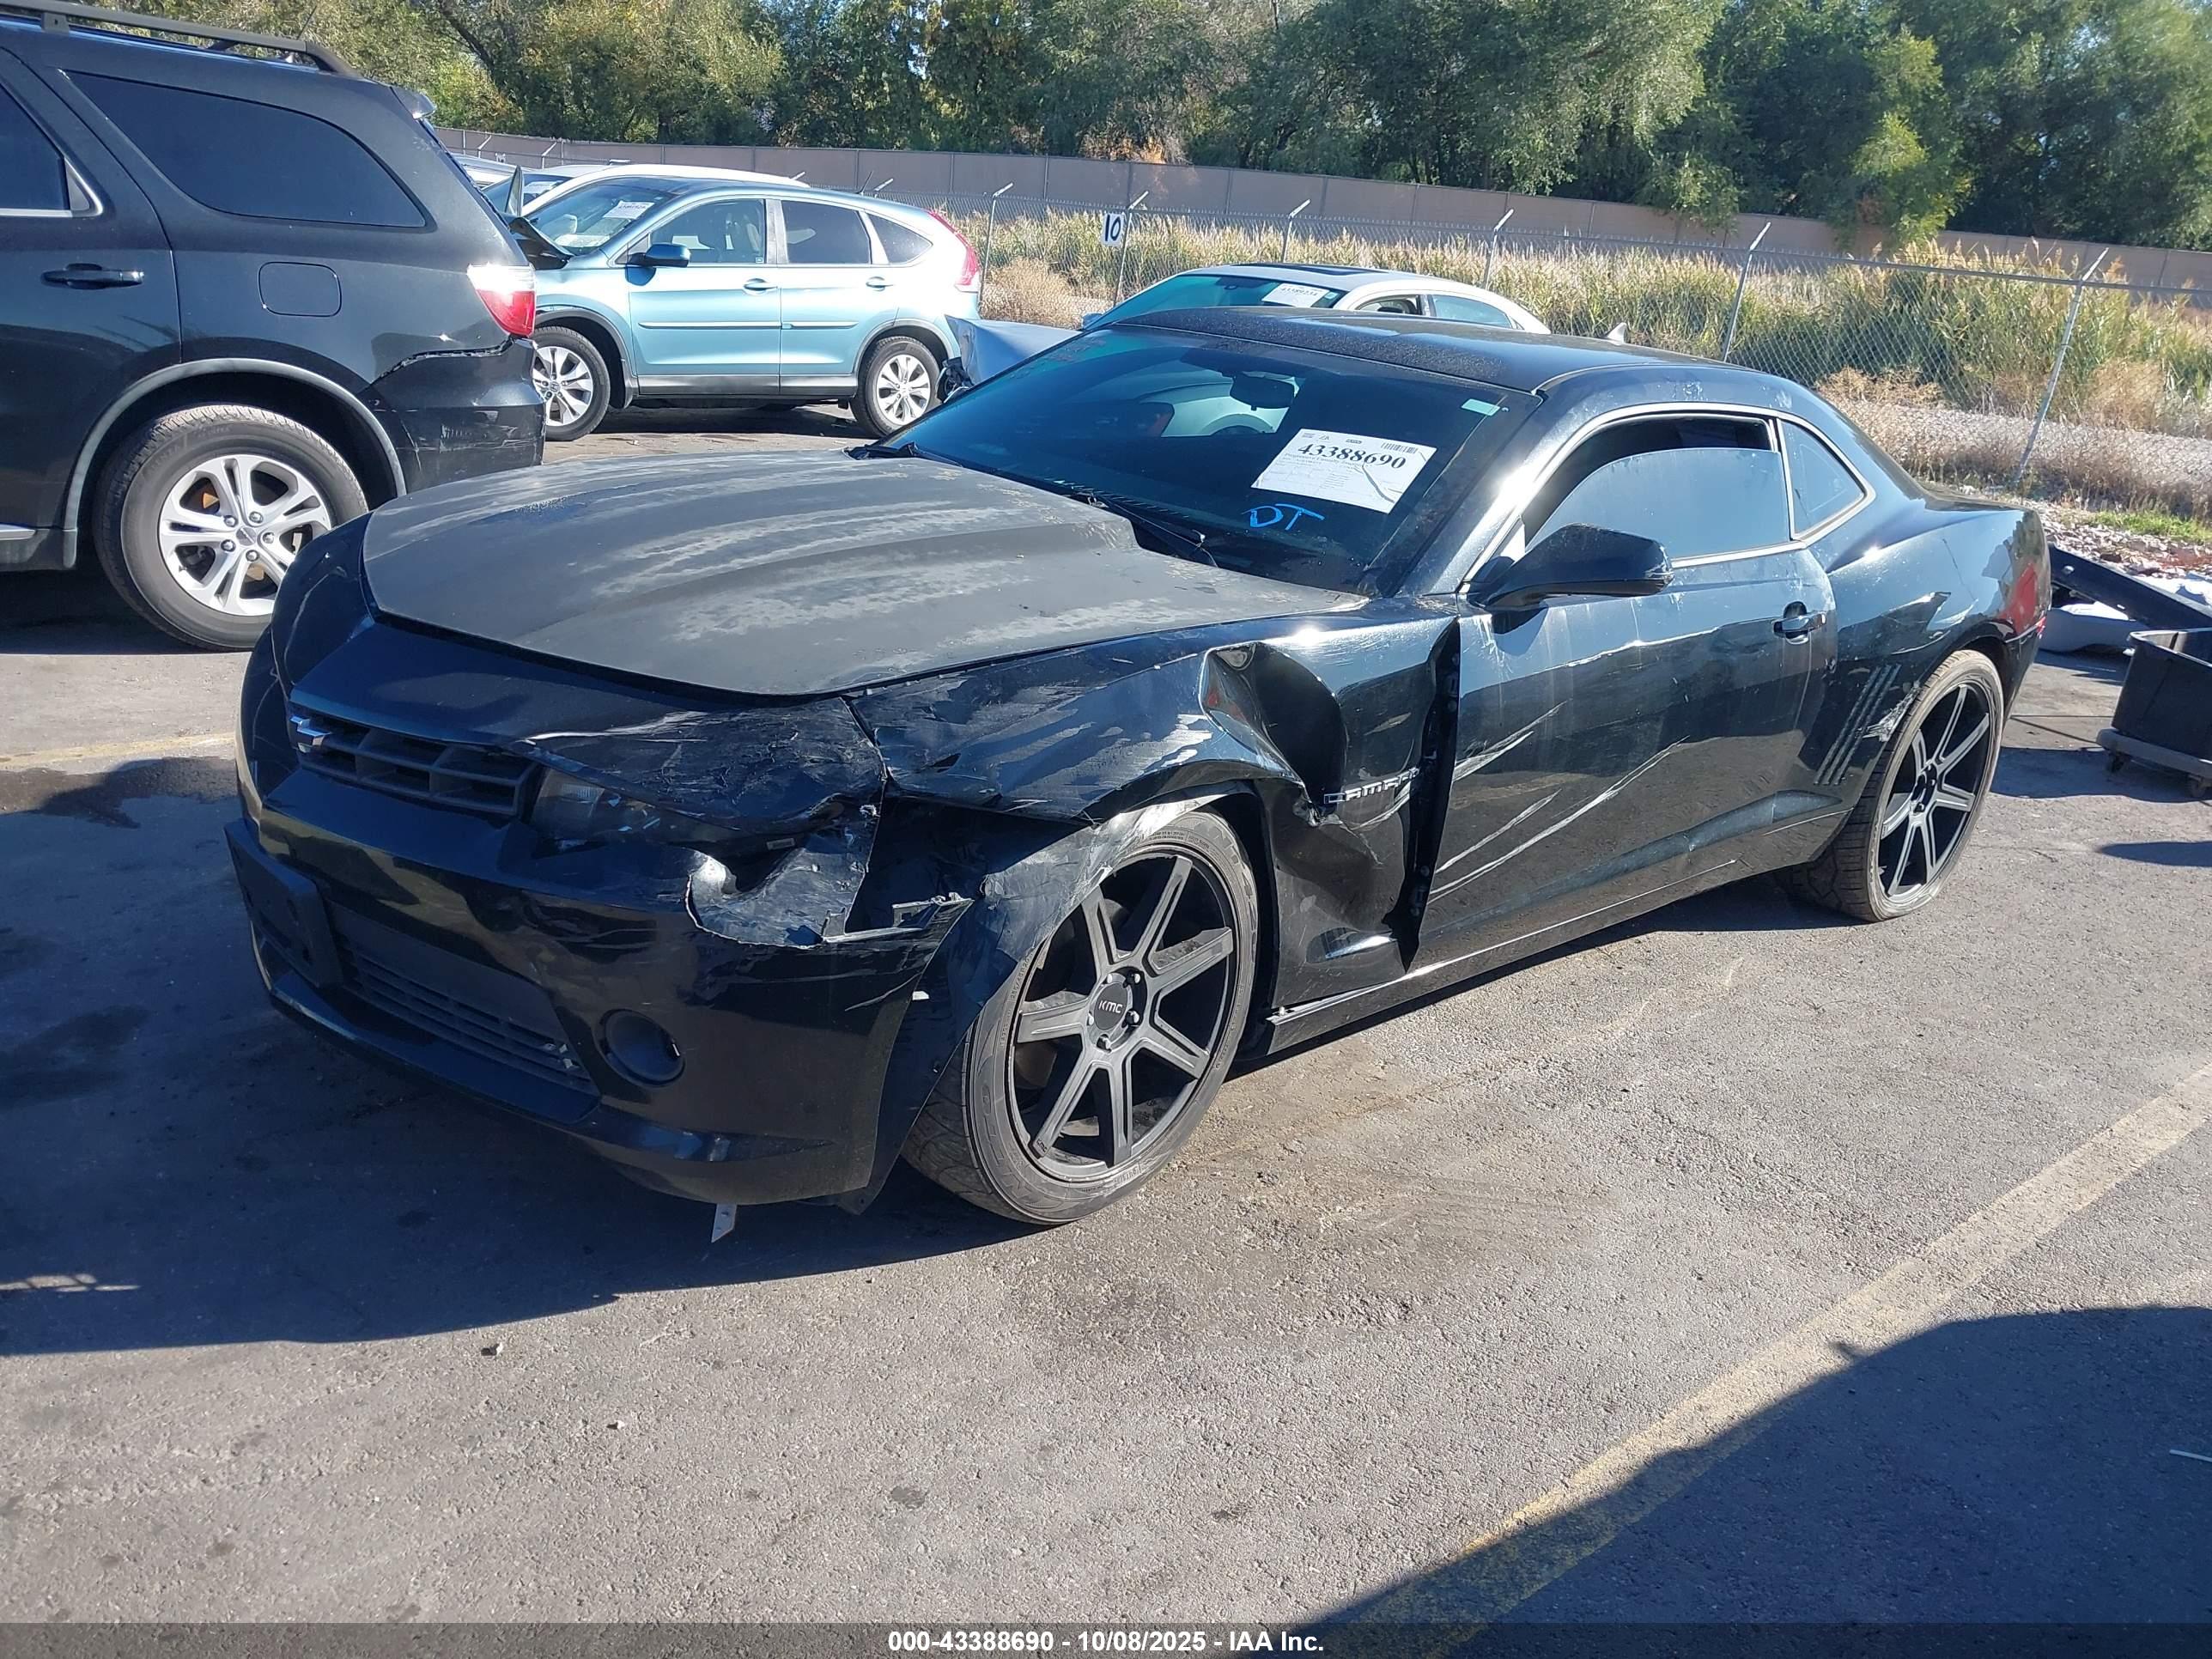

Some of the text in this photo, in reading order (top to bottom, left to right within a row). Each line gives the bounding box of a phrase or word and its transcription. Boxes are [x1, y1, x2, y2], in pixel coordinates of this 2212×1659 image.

[1104, 214, 1121, 242] 10
[1297, 443, 1407, 469] 43388690
[1241, 503, 1325, 531] DT
[1098, 1000, 1123, 1014] KMC
